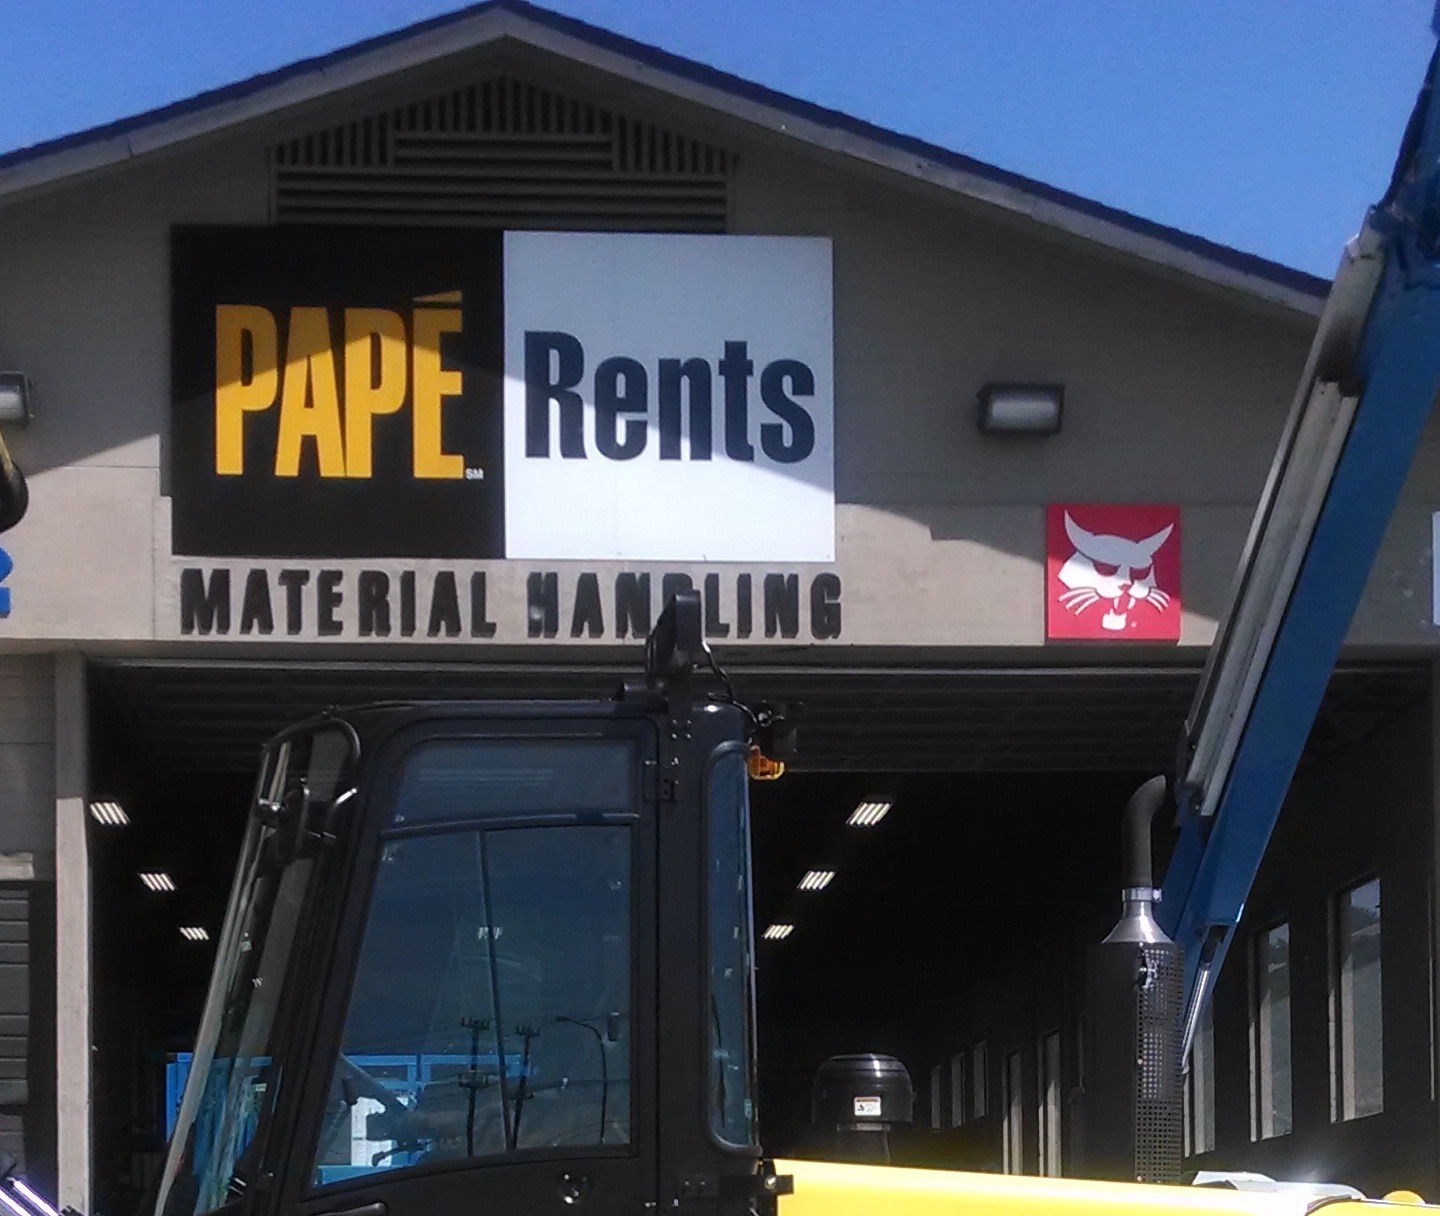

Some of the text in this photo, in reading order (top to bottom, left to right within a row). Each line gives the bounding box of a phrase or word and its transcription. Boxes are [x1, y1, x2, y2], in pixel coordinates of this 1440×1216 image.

[215, 290, 464, 479] PAPÉ
[524, 330, 817, 463] Rents
[179, 568, 498, 638] MATERIAL
